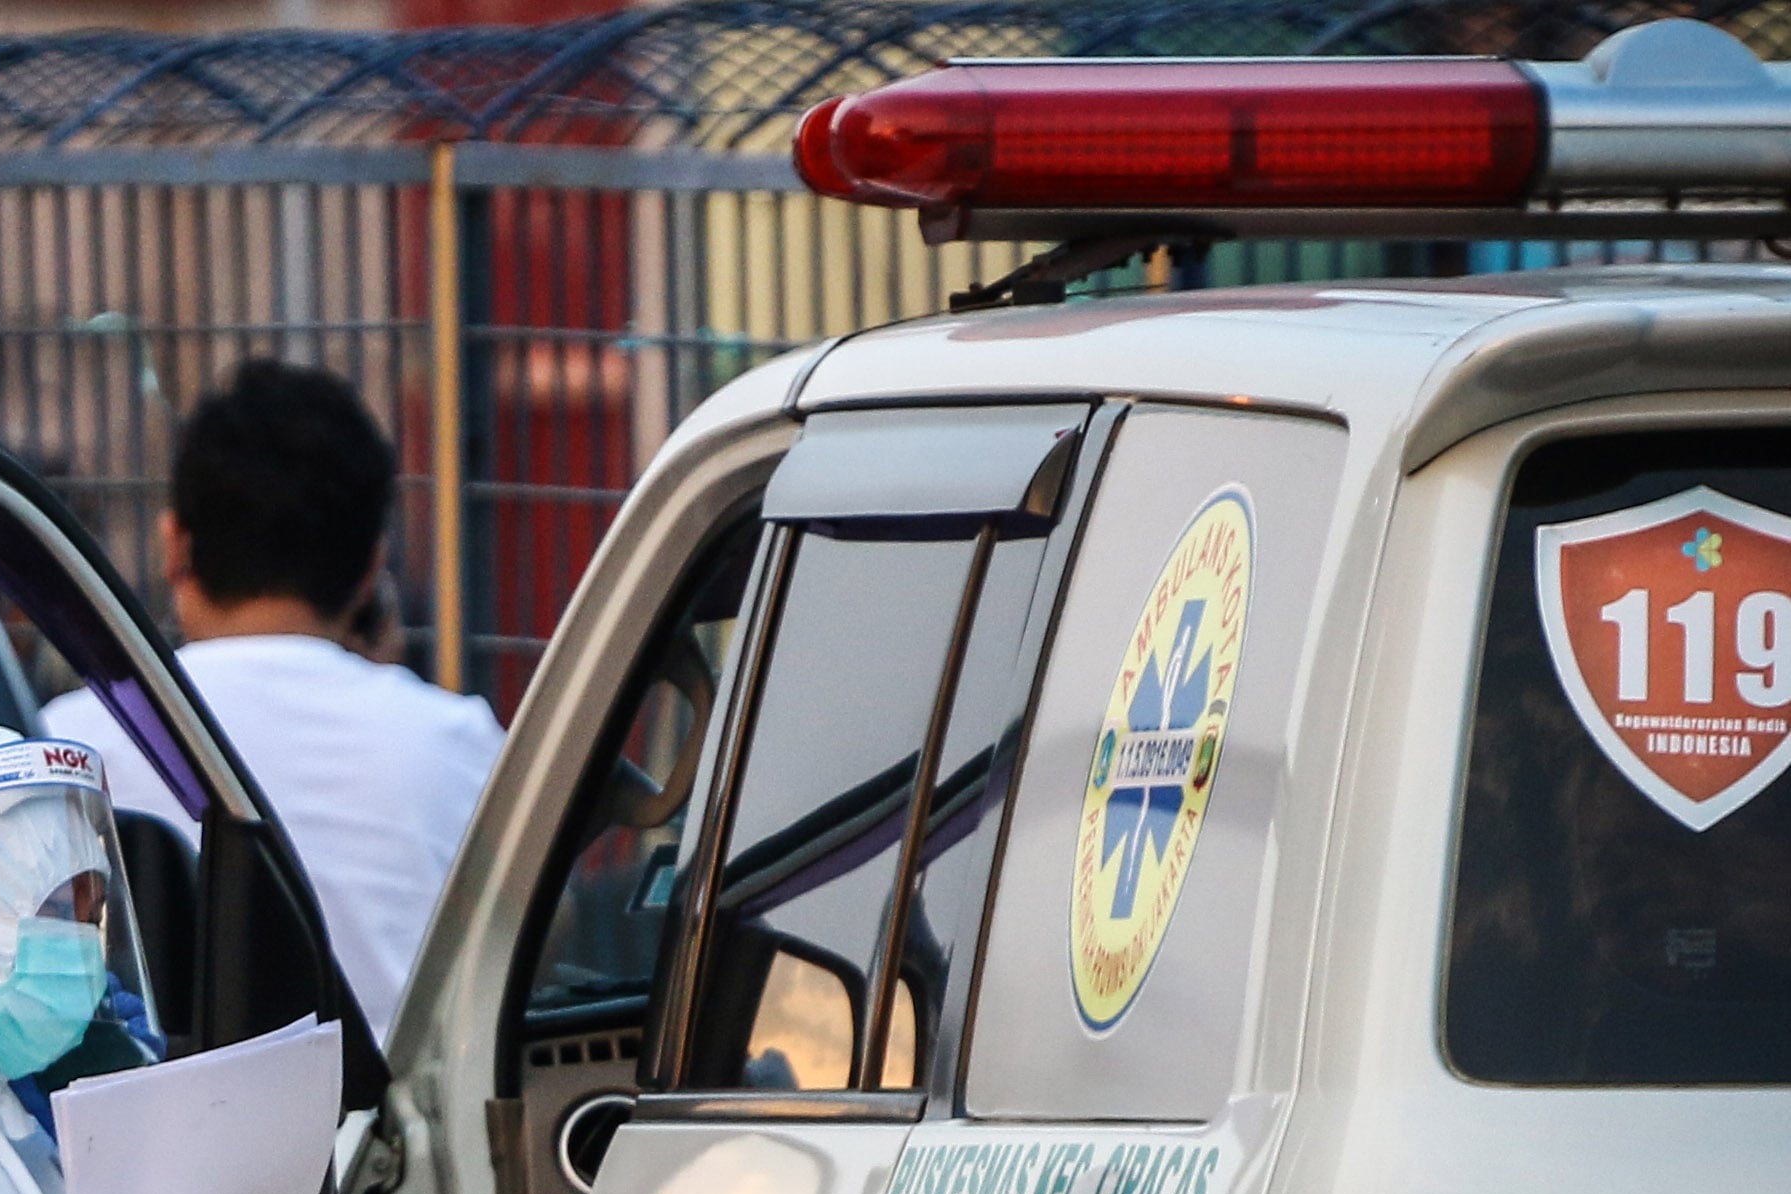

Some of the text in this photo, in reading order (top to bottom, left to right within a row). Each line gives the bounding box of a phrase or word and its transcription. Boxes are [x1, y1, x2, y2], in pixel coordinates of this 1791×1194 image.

[1123, 522, 1242, 704] AMBULANS KOTA
[1601, 588, 1791, 708] 119
[43, 748, 93, 772] NGK
[1648, 733, 1752, 756] INDONESIA
